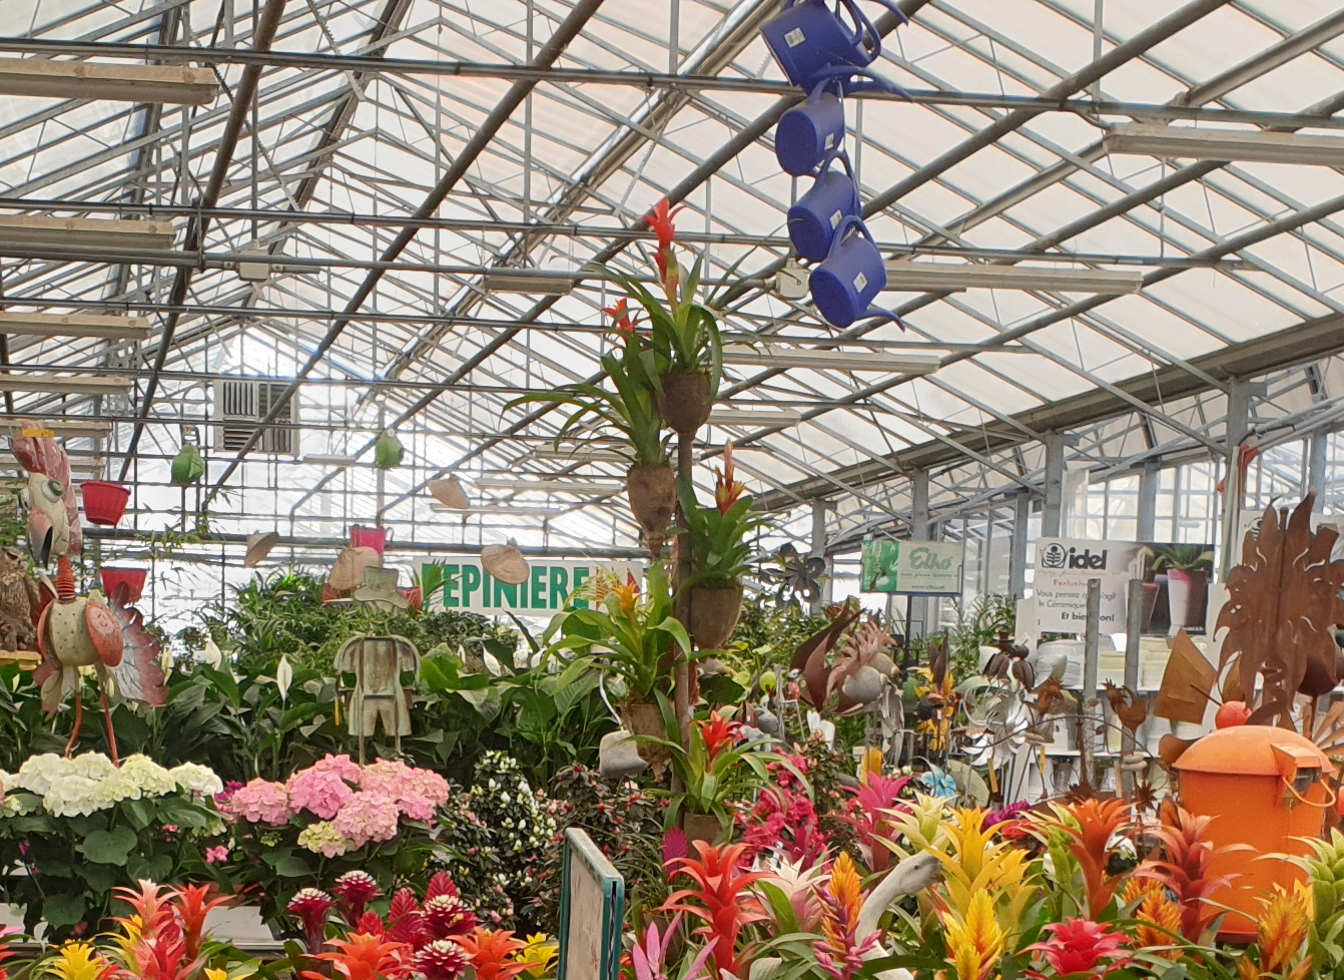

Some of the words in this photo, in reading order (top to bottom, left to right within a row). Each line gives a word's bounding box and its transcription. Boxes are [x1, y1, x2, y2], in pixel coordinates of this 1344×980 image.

[422, 562, 590, 611] EPINIERE
[1053, 579, 1088, 588] Exclusiv
[1036, 588, 1053, 598] Vous
